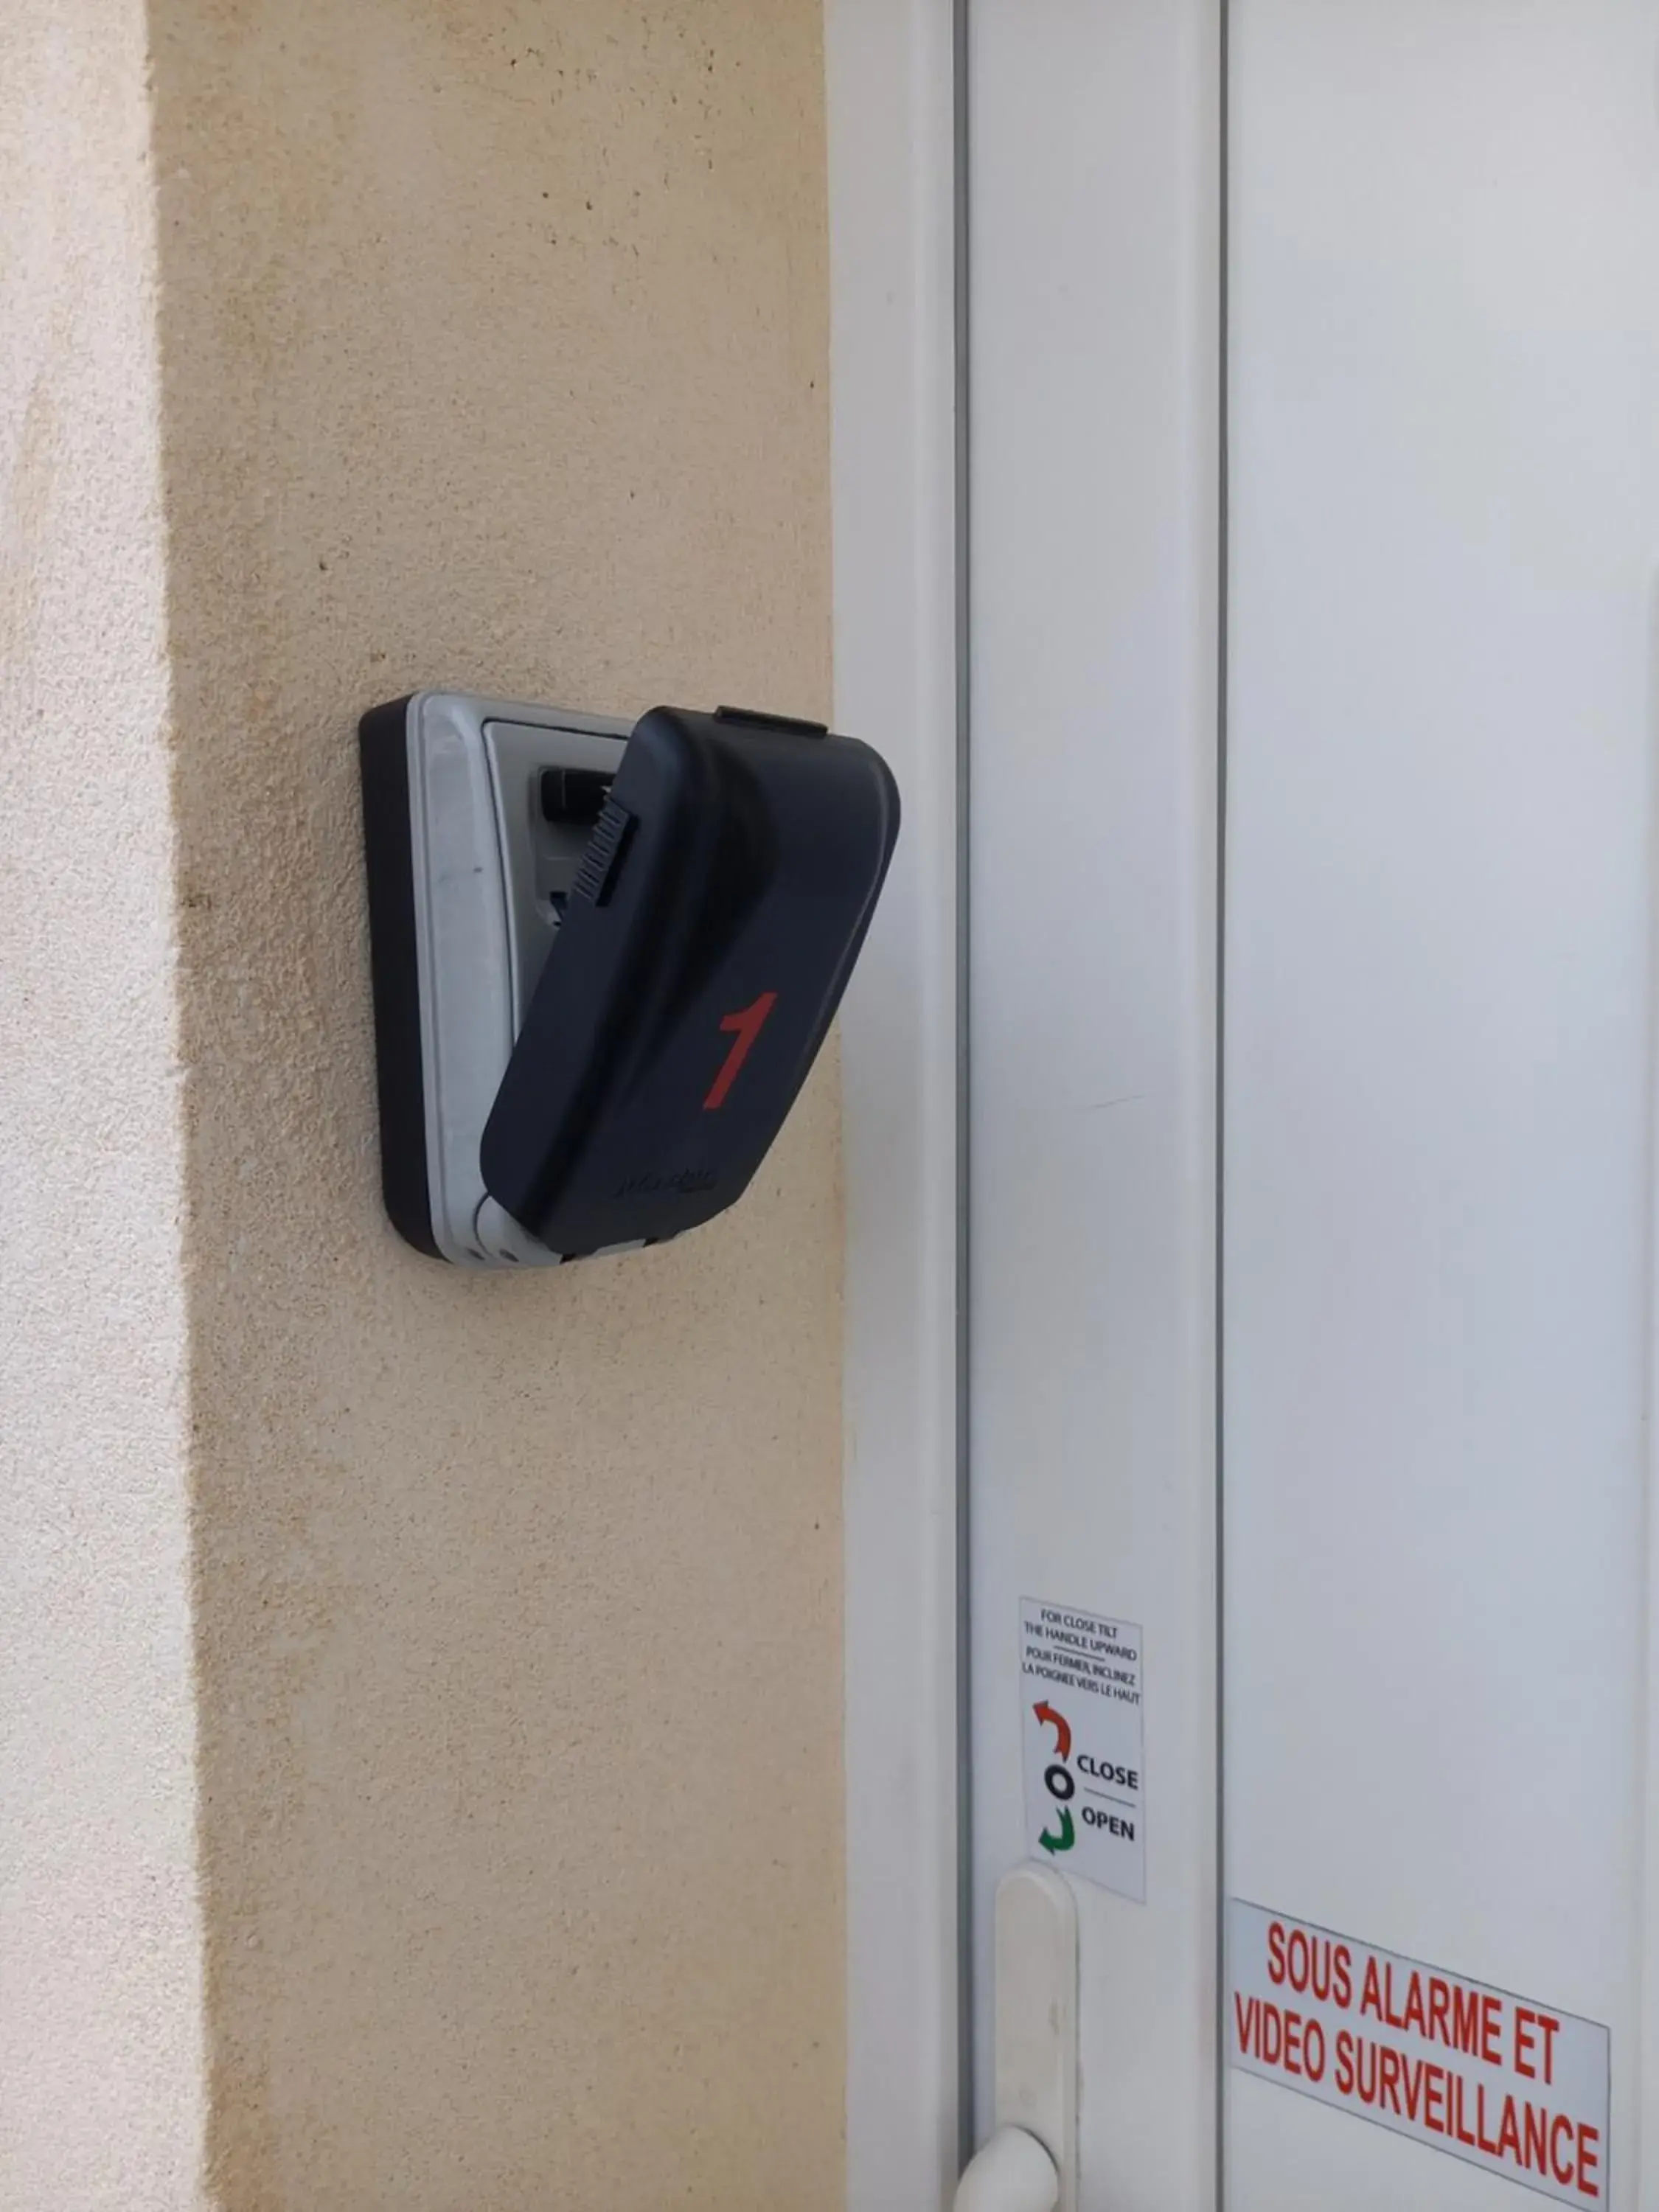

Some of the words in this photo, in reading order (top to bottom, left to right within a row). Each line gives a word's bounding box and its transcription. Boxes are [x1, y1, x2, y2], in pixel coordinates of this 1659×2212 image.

[703, 992, 779, 1110] 1
[1024, 1621, 1043, 1636] THE
[1046, 1627, 1088, 1648] HANDLE
[1090, 1639, 1138, 1660] UPWARD
[1041, 1609, 1061, 1623] FOR
[1063, 1615, 1096, 1632] CLOSE
[1099, 1624, 1118, 1638] TILT
[1022, 1663, 1034, 1674] LA
[1076, 1677, 1099, 1693] VERS
[1101, 1684, 1112, 1697] LE
[1113, 1688, 1141, 1705] HAUT
[1026, 1646, 1051, 1661] POUR
[1092, 1665, 1135, 1686] INCLINEZ
[1077, 1754, 1139, 1790] CLOSE
[1082, 1806, 1135, 1842] OPEN
[1267, 1921, 1352, 2008] SOUS
[1360, 1955, 1502, 2065] ALARME
[1514, 2006, 1560, 2085] ET
[1234, 1991, 1325, 2083] VIDEO
[1335, 2029, 1599, 2198] SURVEILLANCE
